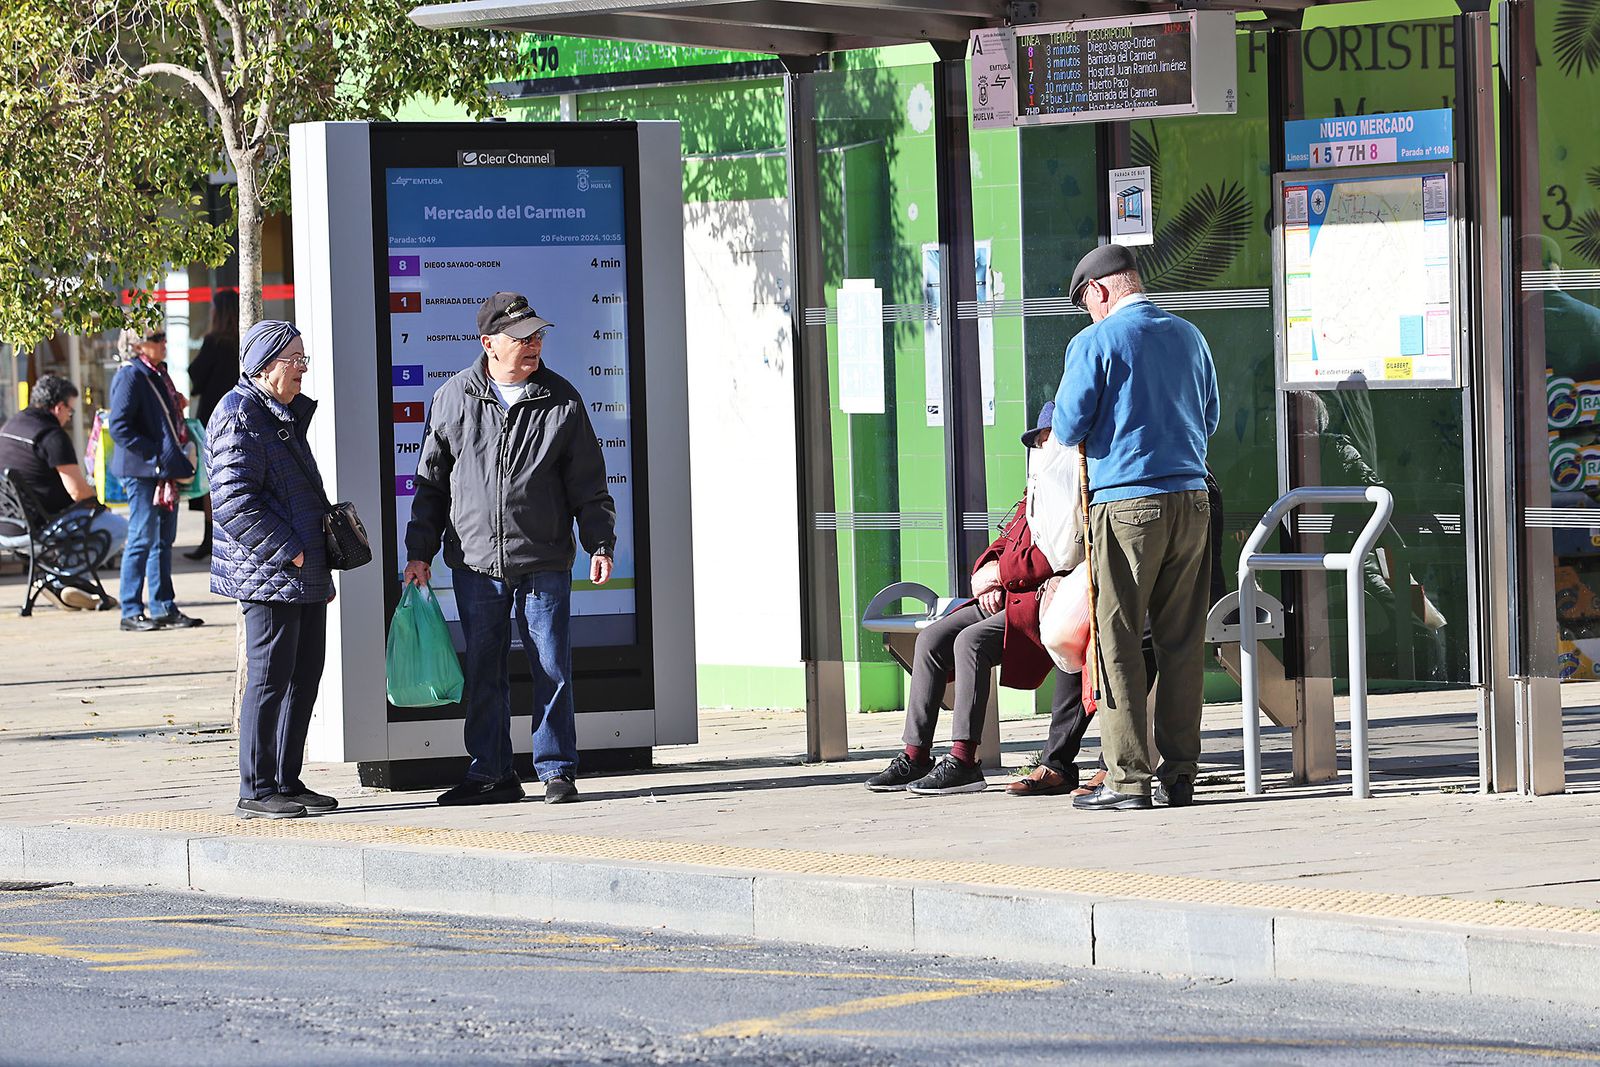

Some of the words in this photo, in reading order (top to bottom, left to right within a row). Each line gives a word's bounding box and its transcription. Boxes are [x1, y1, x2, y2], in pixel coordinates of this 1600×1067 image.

[1049, 31, 1077, 45] TIEMPO
[1027, 46, 1034, 58] 8
[1046, 44, 1052, 56] 3
[1053, 43, 1081, 56] minutos
[1087, 41, 1108, 55] Diego
[1108, 37, 1156, 53] Sayago-Orden
[1028, 58, 1033, 71] 1
[1053, 56, 1081, 69] minutos
[1087, 52, 1117, 65] Barriada
[1117, 49, 1128, 63] del
[1129, 50, 1157, 62] Carmen
[989, 63, 1011, 72] EMTUSA
[1028, 71, 1034, 83] 7
[1046, 70, 1052, 81] 4
[1053, 69, 1081, 81] minutos
[1087, 64, 1116, 78] Hospital
[1116, 62, 1133, 75] Juan
[1133, 60, 1158, 74] Ramón
[1158, 58, 1187, 72] Jiménez
[1028, 83, 1035, 95] 5
[1045, 82, 1055, 94] 10
[1055, 81, 1084, 93] minutos
[1088, 79, 1112, 91] Huerto
[1113, 77, 1129, 89] Paco
[1029, 95, 1035, 107] 1
[1050, 93, 1063, 105] bus
[1065, 91, 1074, 104] 17
[1088, 89, 1117, 102] Barriada
[1117, 88, 1129, 100] del
[1130, 86, 1158, 99] Carmen
[973, 112, 995, 122] HUELVA
[1320, 121, 1358, 139] NUEVO
[1360, 116, 1414, 136] MERCADO
[478, 152, 506, 165] Clear
[507, 152, 550, 164] Channel
[1312, 147, 1319, 164] 1
[1324, 146, 1332, 163] 5
[1335, 146, 1344, 162] 7
[1347, 144, 1366, 161] 7H
[1369, 143, 1378, 160] 8
[1401, 147, 1424, 157] Parada
[1433, 145, 1450, 155] 1049
[412, 178, 444, 186] EMTUSA
[424, 204, 494, 221] Mercado
[496, 204, 521, 220] del
[523, 205, 586, 219] Carmen
[389, 236, 417, 244] Parada:
[418, 235, 436, 243] 1049
[541, 234, 551, 242] 20
[551, 234, 580, 242] Febrero
[602, 233, 622, 241] 10:55
[398, 260, 407, 271] 8
[424, 261, 446, 269] DIEGO
[446, 260, 501, 269] SAYAGO-ORDEN
[591, 257, 599, 269] 4
[600, 257, 621, 268] min
[400, 296, 407, 308] 1
[462, 297, 476, 305] DEL
[592, 293, 600, 305] 4
[601, 293, 622, 304] min
[401, 333, 409, 344] 7
[426, 334, 460, 342] HOSPITAL
[593, 329, 601, 341] 4
[602, 329, 623, 340] min
[402, 369, 410, 381] 5
[588, 365, 602, 377] 10
[603, 365, 625, 376] min
[403, 406, 411, 417] 1
[590, 402, 603, 413] 17
[605, 401, 626, 412] min
[396, 443, 420, 454] 7HP
[606, 437, 626, 448] min
[405, 479, 414, 490] 8
[607, 473, 627, 484] min
